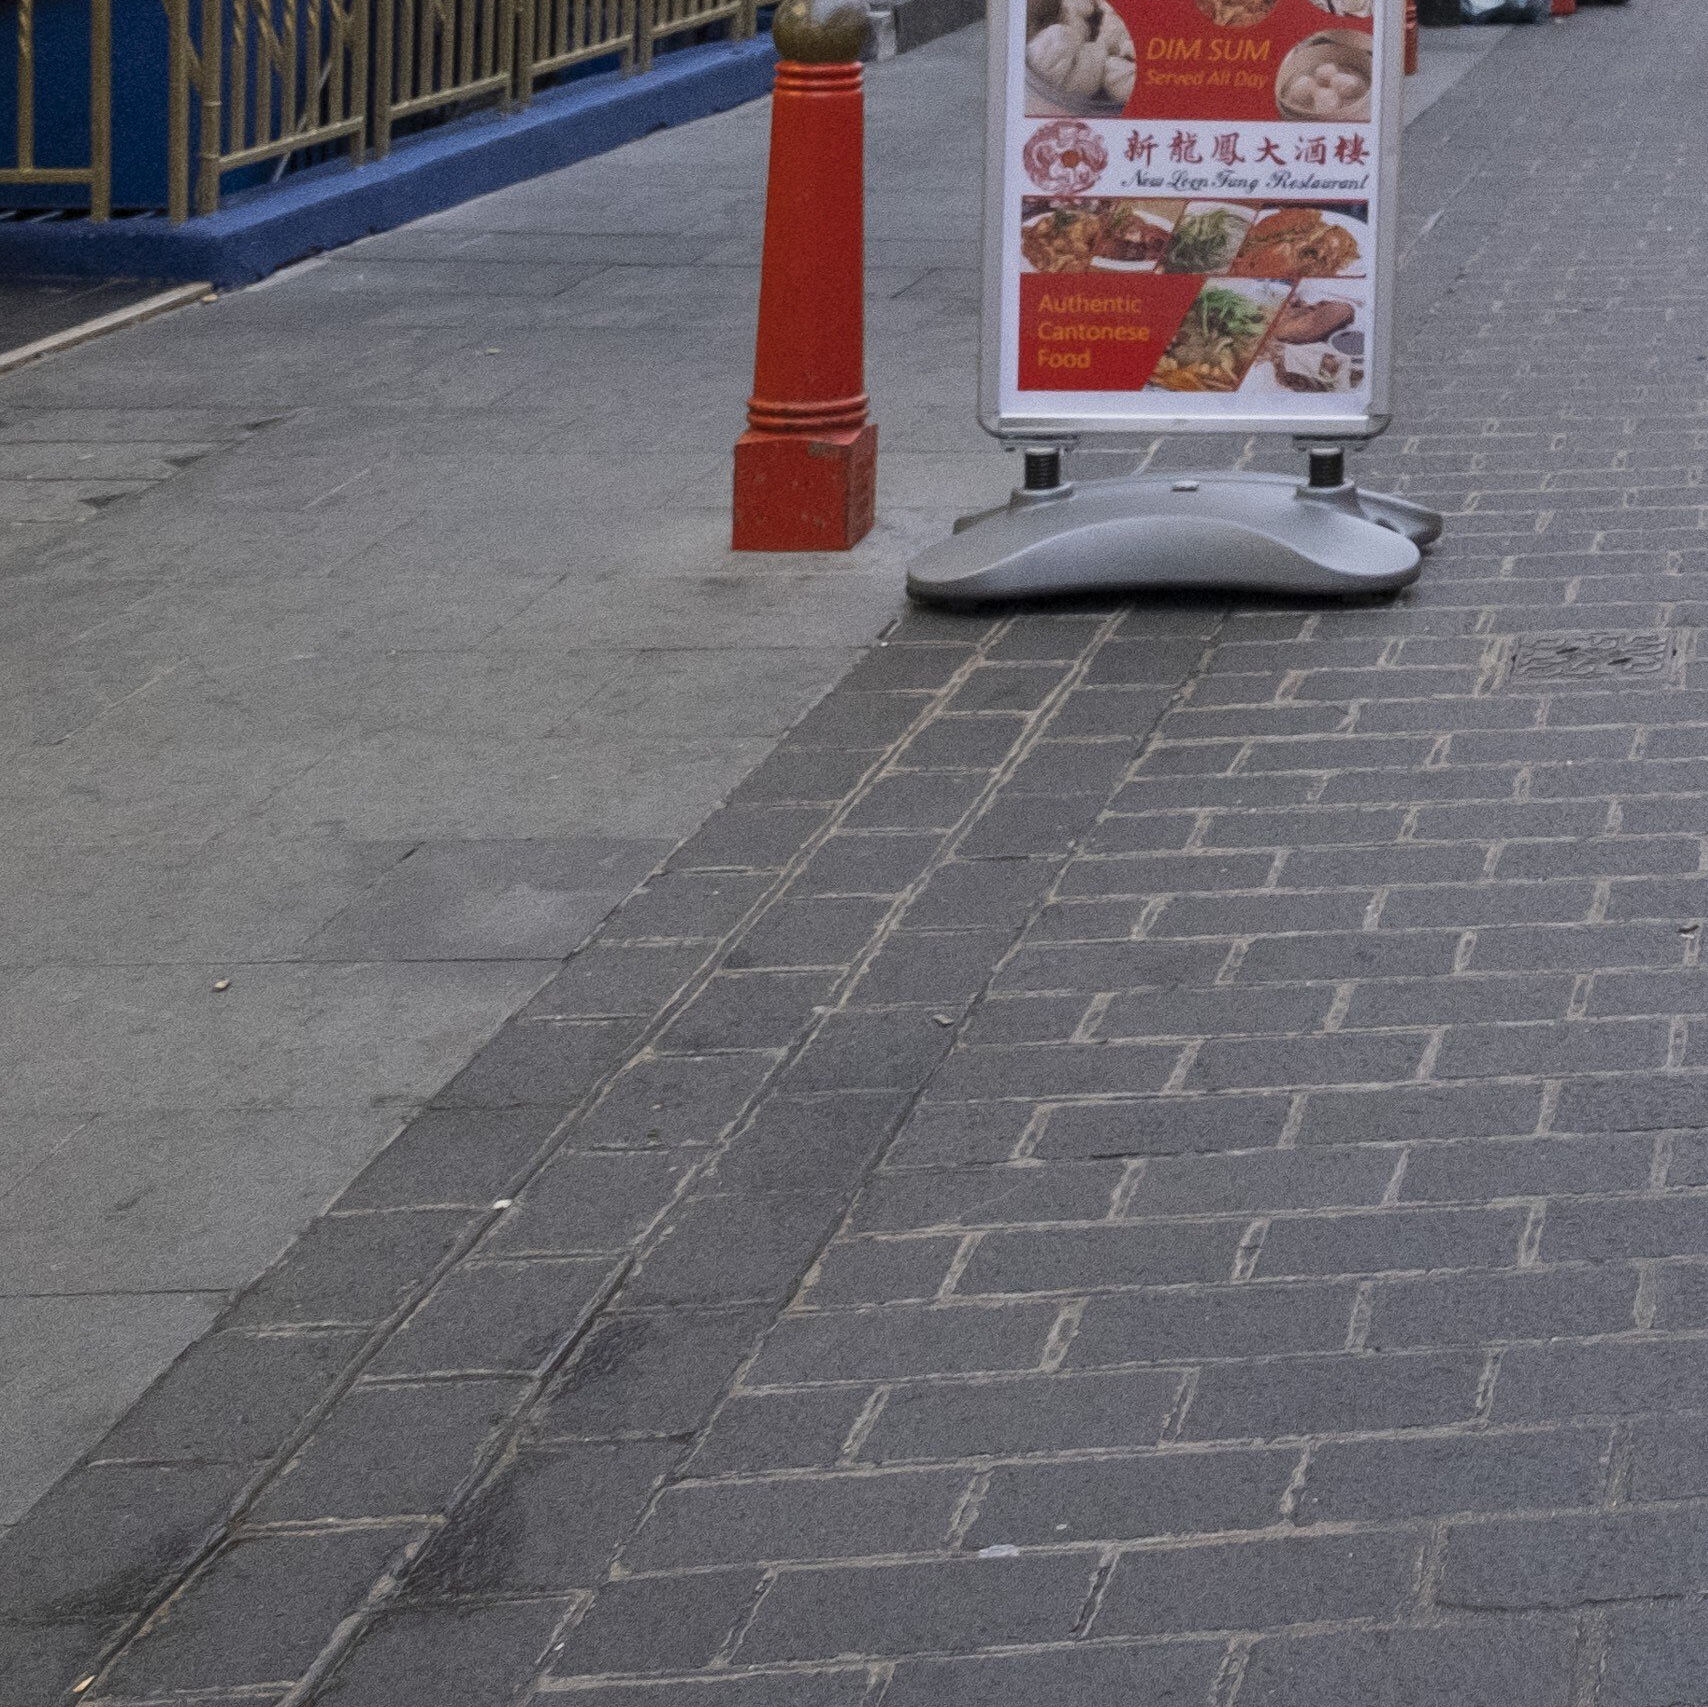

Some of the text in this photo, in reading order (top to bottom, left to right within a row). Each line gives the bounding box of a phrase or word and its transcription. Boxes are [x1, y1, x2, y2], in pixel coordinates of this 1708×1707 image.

[1146, 36, 1271, 62] DIM SUM
[1146, 68, 1268, 91] Served All Day
[1123, 128, 1371, 167] 新龍鳳大酒樓
[1121, 168, 1165, 189] New
[1263, 168, 1370, 190] Restaurant
[1038, 293, 1141, 314] Authentic
[1037, 322, 1150, 342] Cantonese
[1037, 349, 1091, 369] Food
